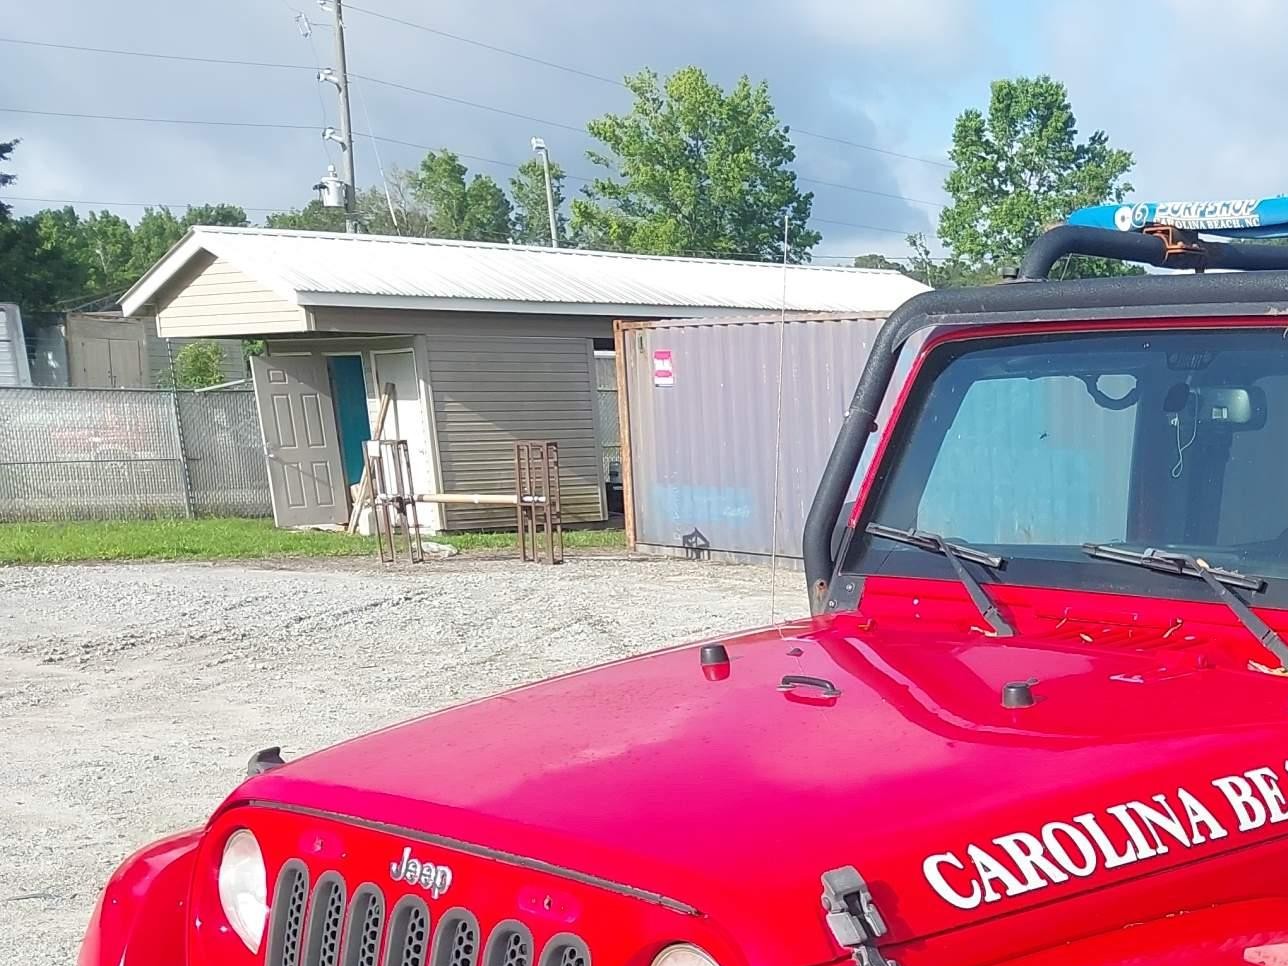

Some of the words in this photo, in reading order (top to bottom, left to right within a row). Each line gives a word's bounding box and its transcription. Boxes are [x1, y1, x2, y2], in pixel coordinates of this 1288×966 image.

[1246, 217, 1261, 228] NC
[389, 846, 453, 900] Jeep
[921, 786, 1228, 911] CAROLINA
